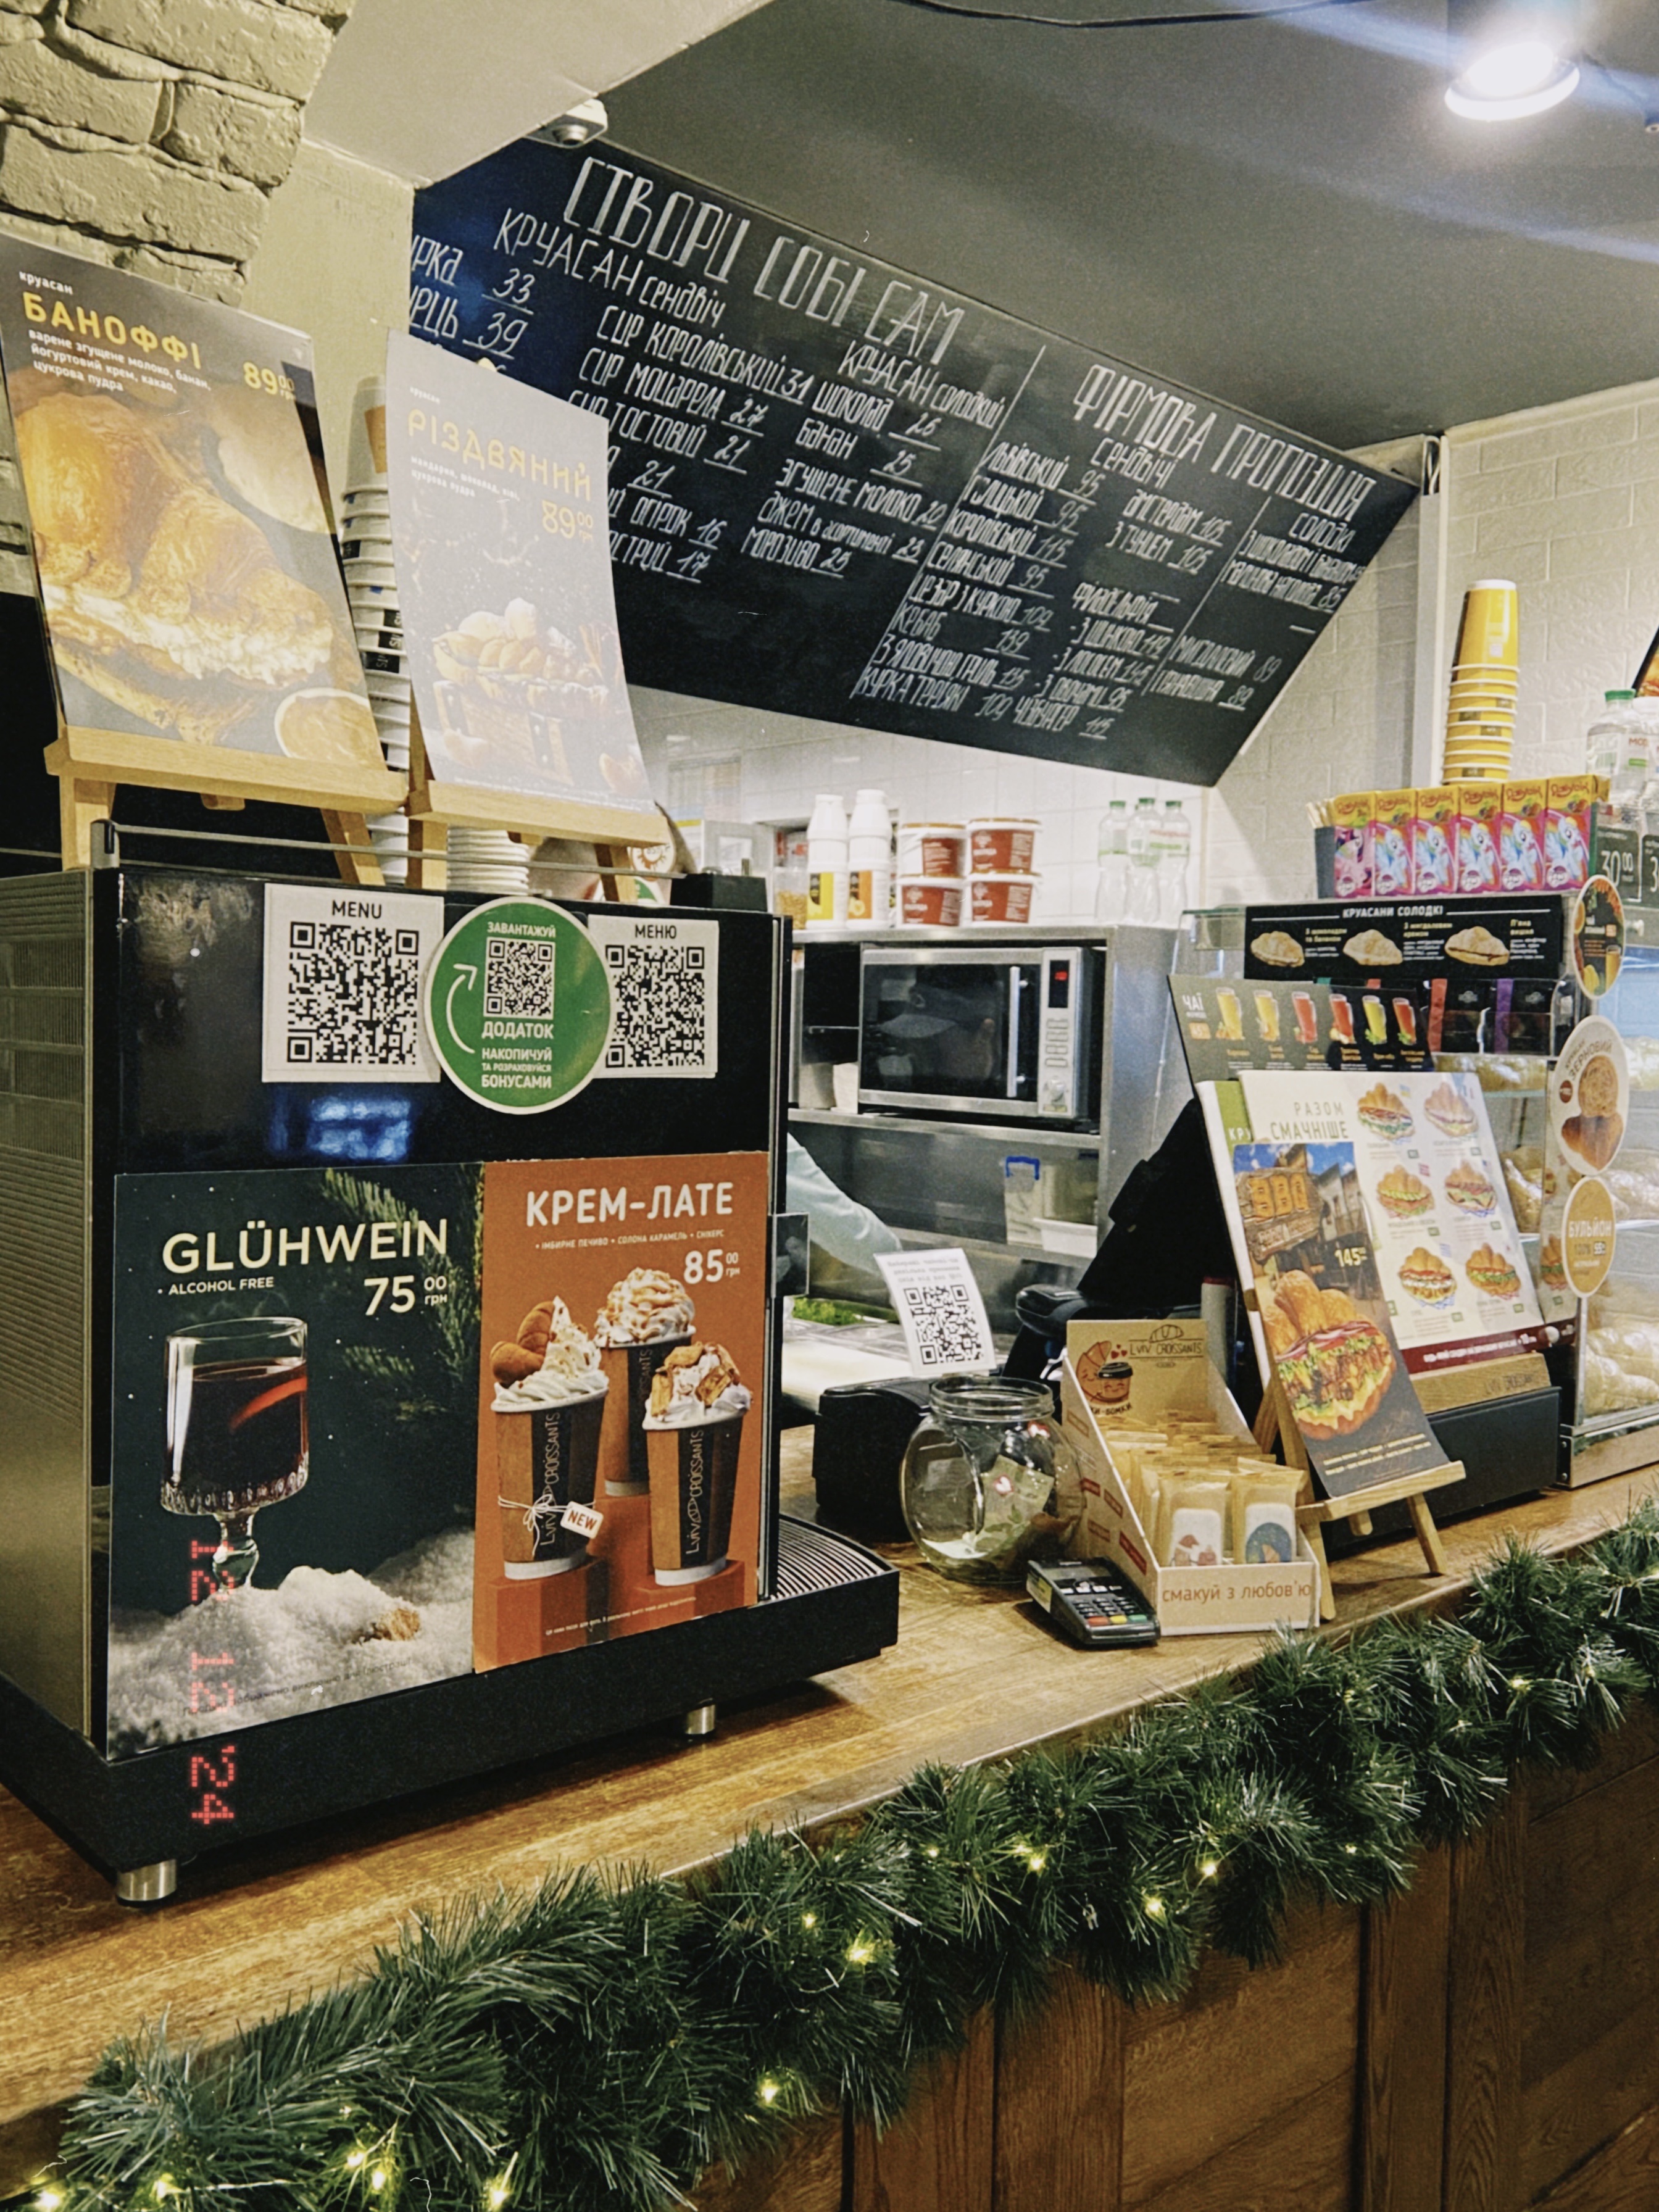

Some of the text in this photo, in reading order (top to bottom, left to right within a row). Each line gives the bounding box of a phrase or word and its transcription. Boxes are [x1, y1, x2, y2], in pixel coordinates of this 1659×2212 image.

[494, 208, 643, 296] КРУАСАН
[563, 157, 965, 365] СТВОРИ СОБІ САМ
[19, 270, 73, 296] круасан
[493, 268, 535, 304] 33
[23, 291, 201, 369] БАНОФФІ
[478, 311, 528, 349] 39
[29, 330, 212, 391] варене згущене молоко, банан,
[31, 345, 177, 394] йогуртовий крем, какао,
[580, 347, 625, 387] СИР
[597, 306, 815, 401] СИР КОРОЛІВСЬКИЙ 31
[33, 360, 124, 393] цукрова пудра
[243, 362, 278, 396] 89
[837, 339, 940, 406] КРУАСАН
[609, 402, 707, 458] ТОСТОВИЙ
[1073, 364, 1377, 523] ФІРМОВА ПРОПОЗИЦІЯ
[407, 409, 591, 502] РІЗДВЯНИЙ
[981, 441, 1106, 497] ЛЬВІВСЬКИЙ 95
[633, 460, 675, 489] 21
[542, 499, 576, 539] 89
[576, 511, 594, 529] 00
[852, 482, 922, 523] МОЛОКО
[697, 518, 727, 544] 16
[1200, 515, 1233, 540] 105
[741, 527, 821, 570] МОРОЗИВО
[1033, 534, 1075, 562] 115
[1176, 544, 1213, 572] 105
[1019, 564, 1049, 589] 95
[892, 602, 1030, 654] КЕБАБ 139
[855, 666, 914, 702] КУРКА
[1254, 655, 1283, 683] 89
[331, 900, 383, 919] MENU
[1342, 906, 1443, 918] КРУАСАНИ СОЛОДКІ
[487, 921, 555, 938] ЗАВАНТАЖУЙ
[634, 925, 677, 940] МЕНЮ
[1183, 992, 1204, 1011] ЧАЇ
[481, 1021, 554, 1039] ДОДАТОК
[482, 1047, 552, 1061] НАКОПИЧУЙ
[482, 1063, 551, 1073] ТА РОЗРАХОВУЙСЯ
[481, 1075, 551, 1088] БОНУСАМИ
[1294, 1102, 1343, 1116] РАЗОМ
[1270, 1121, 1349, 1140] СМАЧНІШЕ
[526, 1182, 733, 1227] КРЕМ-ЛАТЕ
[542, 1229, 724, 1249] ІМБИРНЕ ПЕЧИВО СОЛОНА КАРАМЕЛЬ СНІКЕРС
[1569, 1217, 1611, 1238] БУЛЬЙОН
[162, 1218, 447, 1273] GLÜHWEIN
[1334, 1247, 1362, 1267] 145
[684, 1249, 740, 1284] 85 00 грн
[168, 1276, 274, 1295] ALCOHOL FREE
[364, 1275, 447, 1316] 75 00 грн
[1156, 1342, 1203, 1355] CROISSANTS
[544, 1413, 560, 1485] CROISSANTS
[689, 1429, 704, 1497] CROISSANTS
[568, 1510, 596, 1531] NEW
[1162, 1579, 1312, 1604] смакуй з любов'ю
